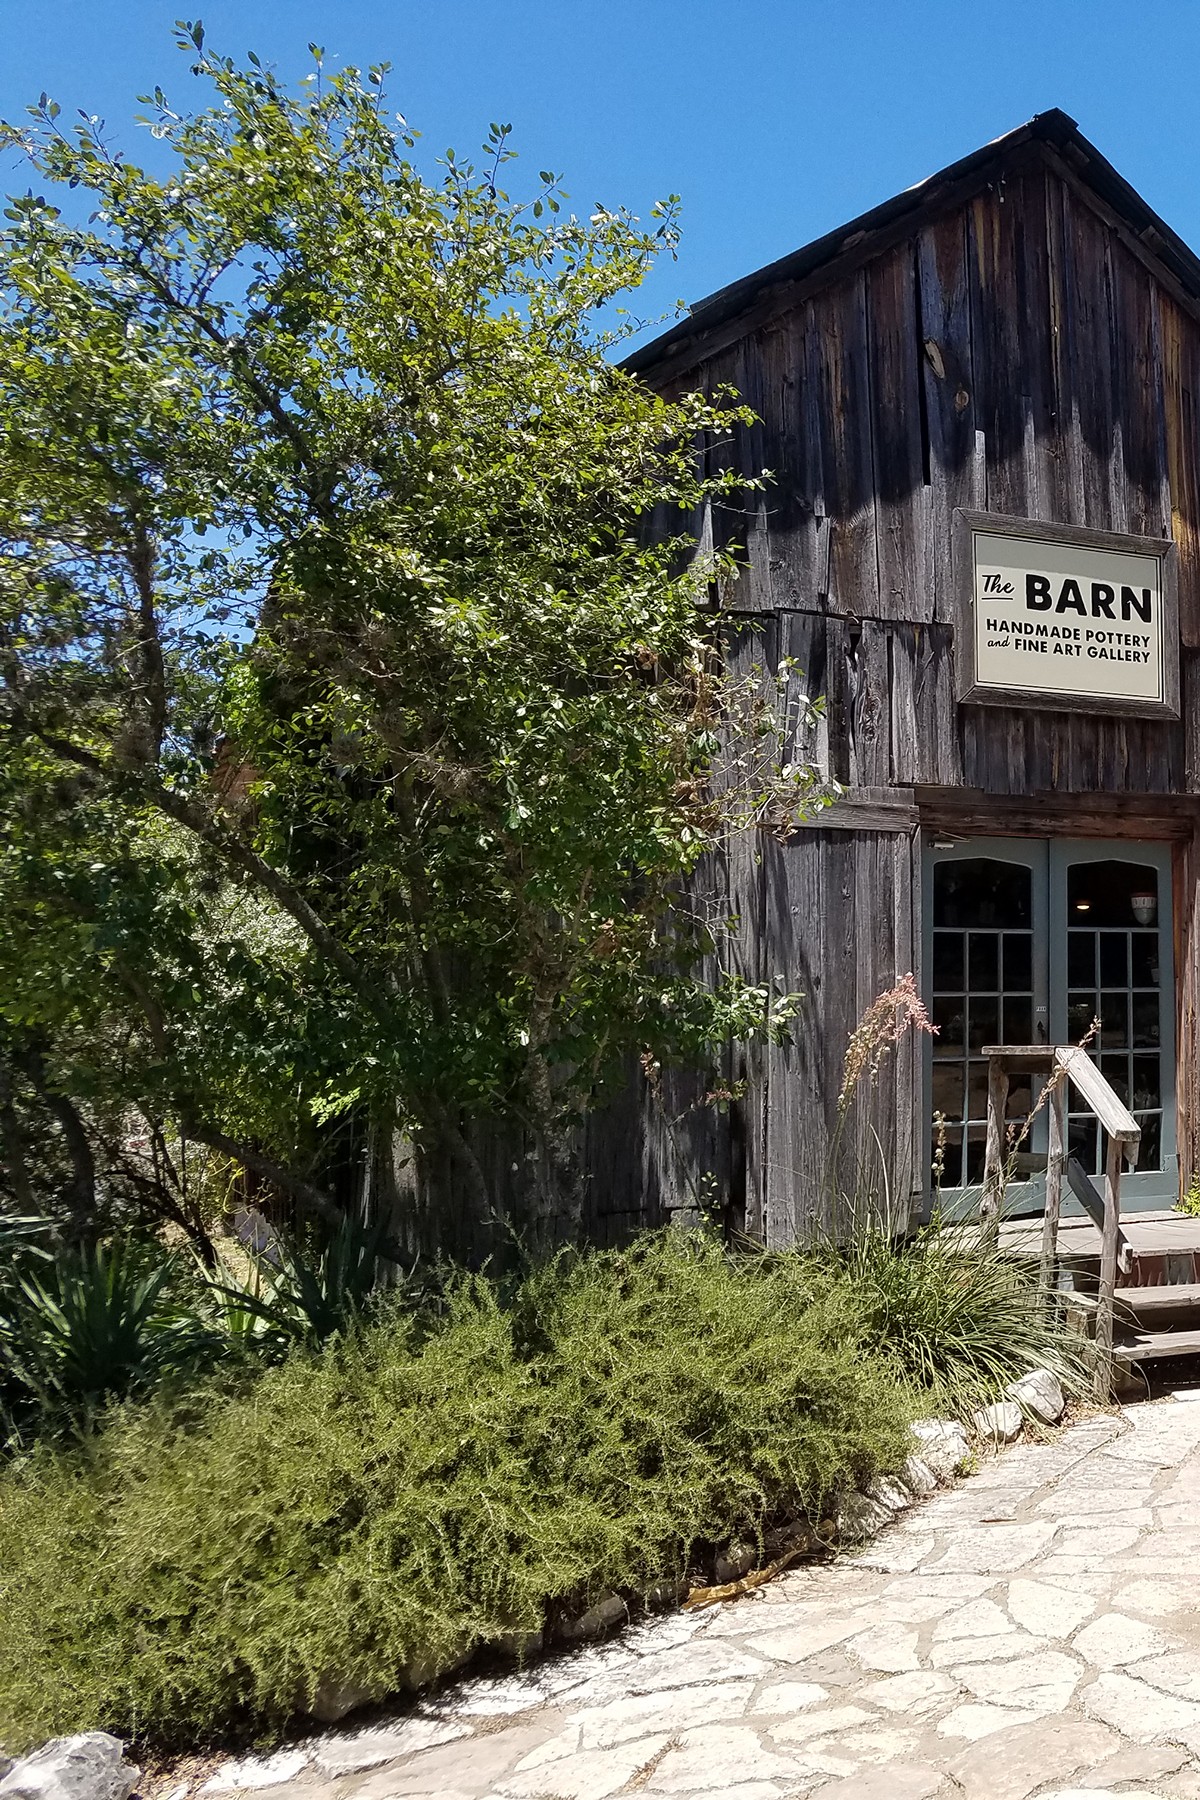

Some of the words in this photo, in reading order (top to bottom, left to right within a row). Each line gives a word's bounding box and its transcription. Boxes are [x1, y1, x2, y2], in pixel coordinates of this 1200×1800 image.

[981, 573, 1015, 594] The
[1025, 573, 1152, 623] BARN
[986, 618, 1081, 641] HANDMADE
[1086, 630, 1150, 648] POTTERY
[987, 636, 1011, 648] and
[1014, 638, 1048, 653] FINE
[1053, 642, 1082, 657] ART
[1087, 646, 1150, 664] GALLERY
